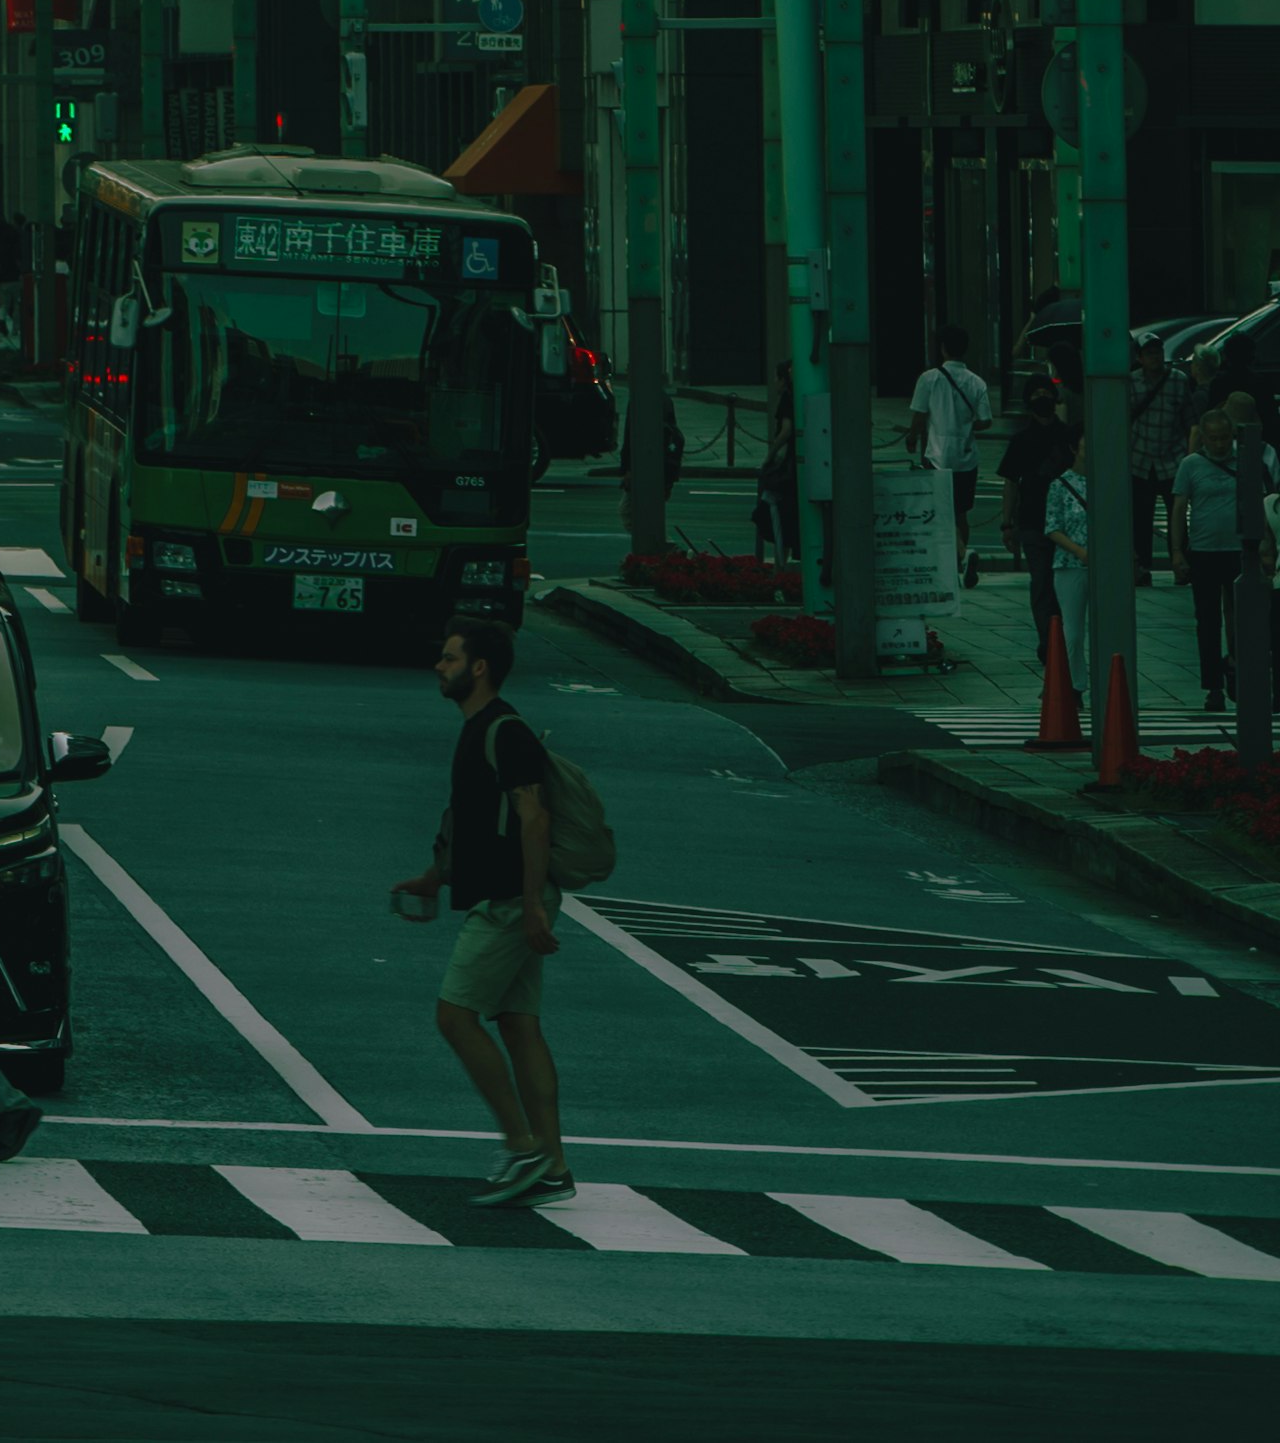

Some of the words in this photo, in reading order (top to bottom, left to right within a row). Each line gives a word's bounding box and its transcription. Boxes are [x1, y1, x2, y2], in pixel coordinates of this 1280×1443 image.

[480, 35, 522, 48] 歩行者優先
[59, 44, 106, 69] 309
[238, 224, 278, 258] 東42
[283, 220, 442, 260] 南千住車庫
[455, 475, 485, 487] G765
[264, 546, 394, 571] ノンステップバス
